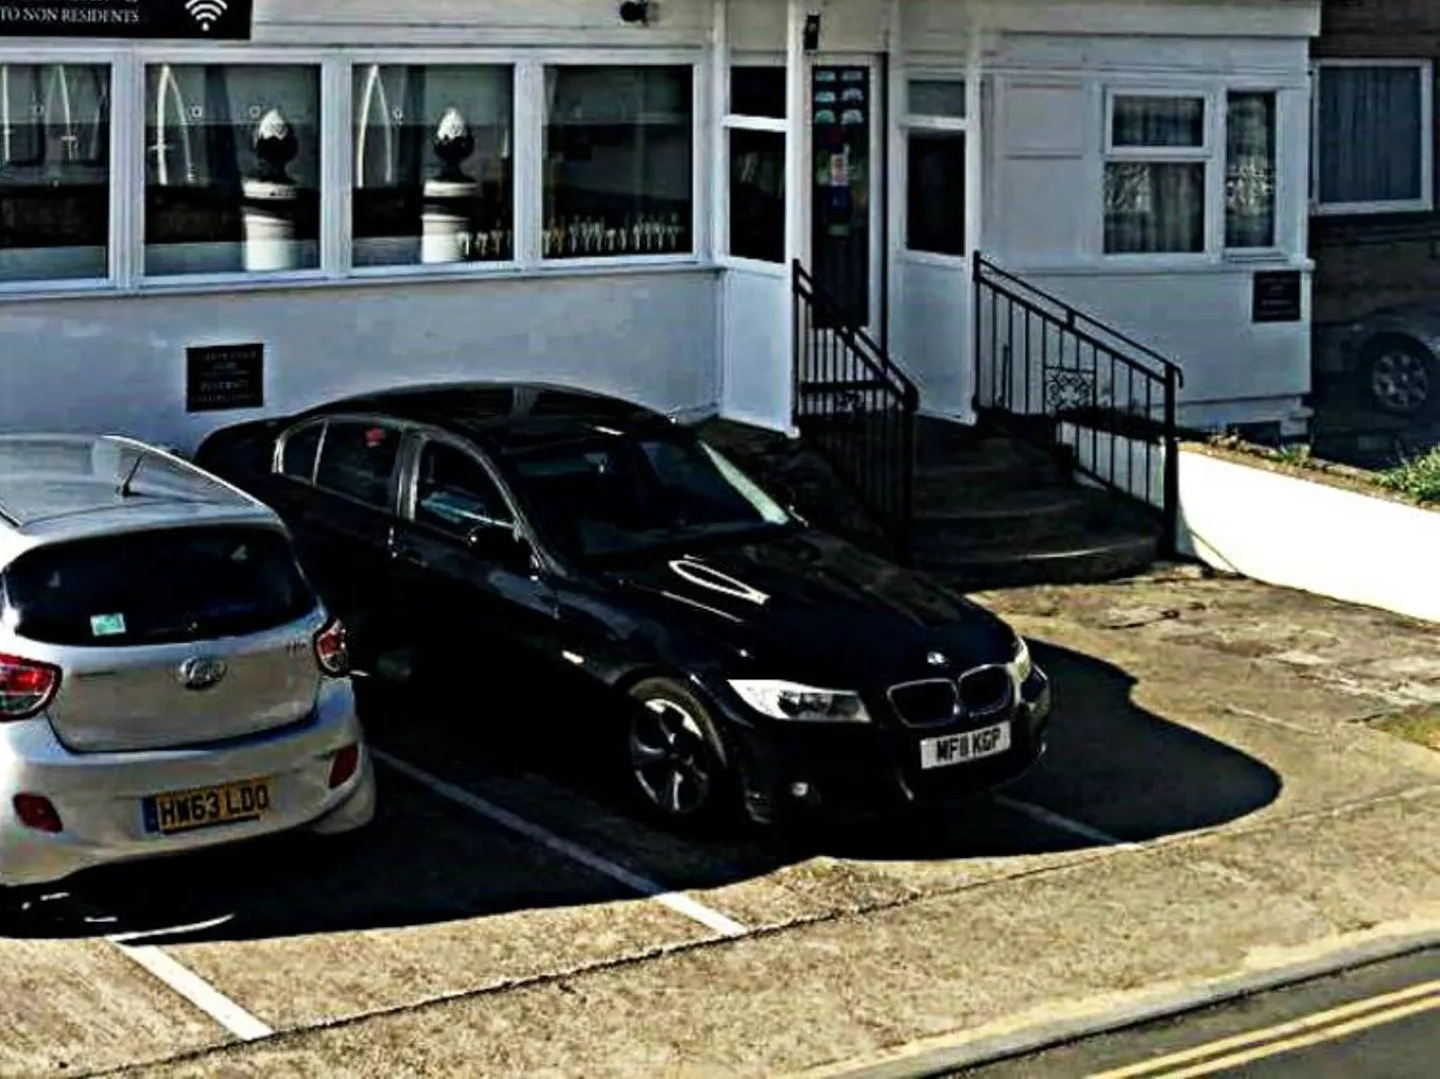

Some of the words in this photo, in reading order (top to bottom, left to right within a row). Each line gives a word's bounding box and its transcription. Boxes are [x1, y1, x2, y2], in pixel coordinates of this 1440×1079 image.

[61, 7, 140, 24] RESIDENTS
[972, 728, 1002, 753] KGP
[160, 792, 220, 825] HW63
[226, 784, 270, 814] LDO
